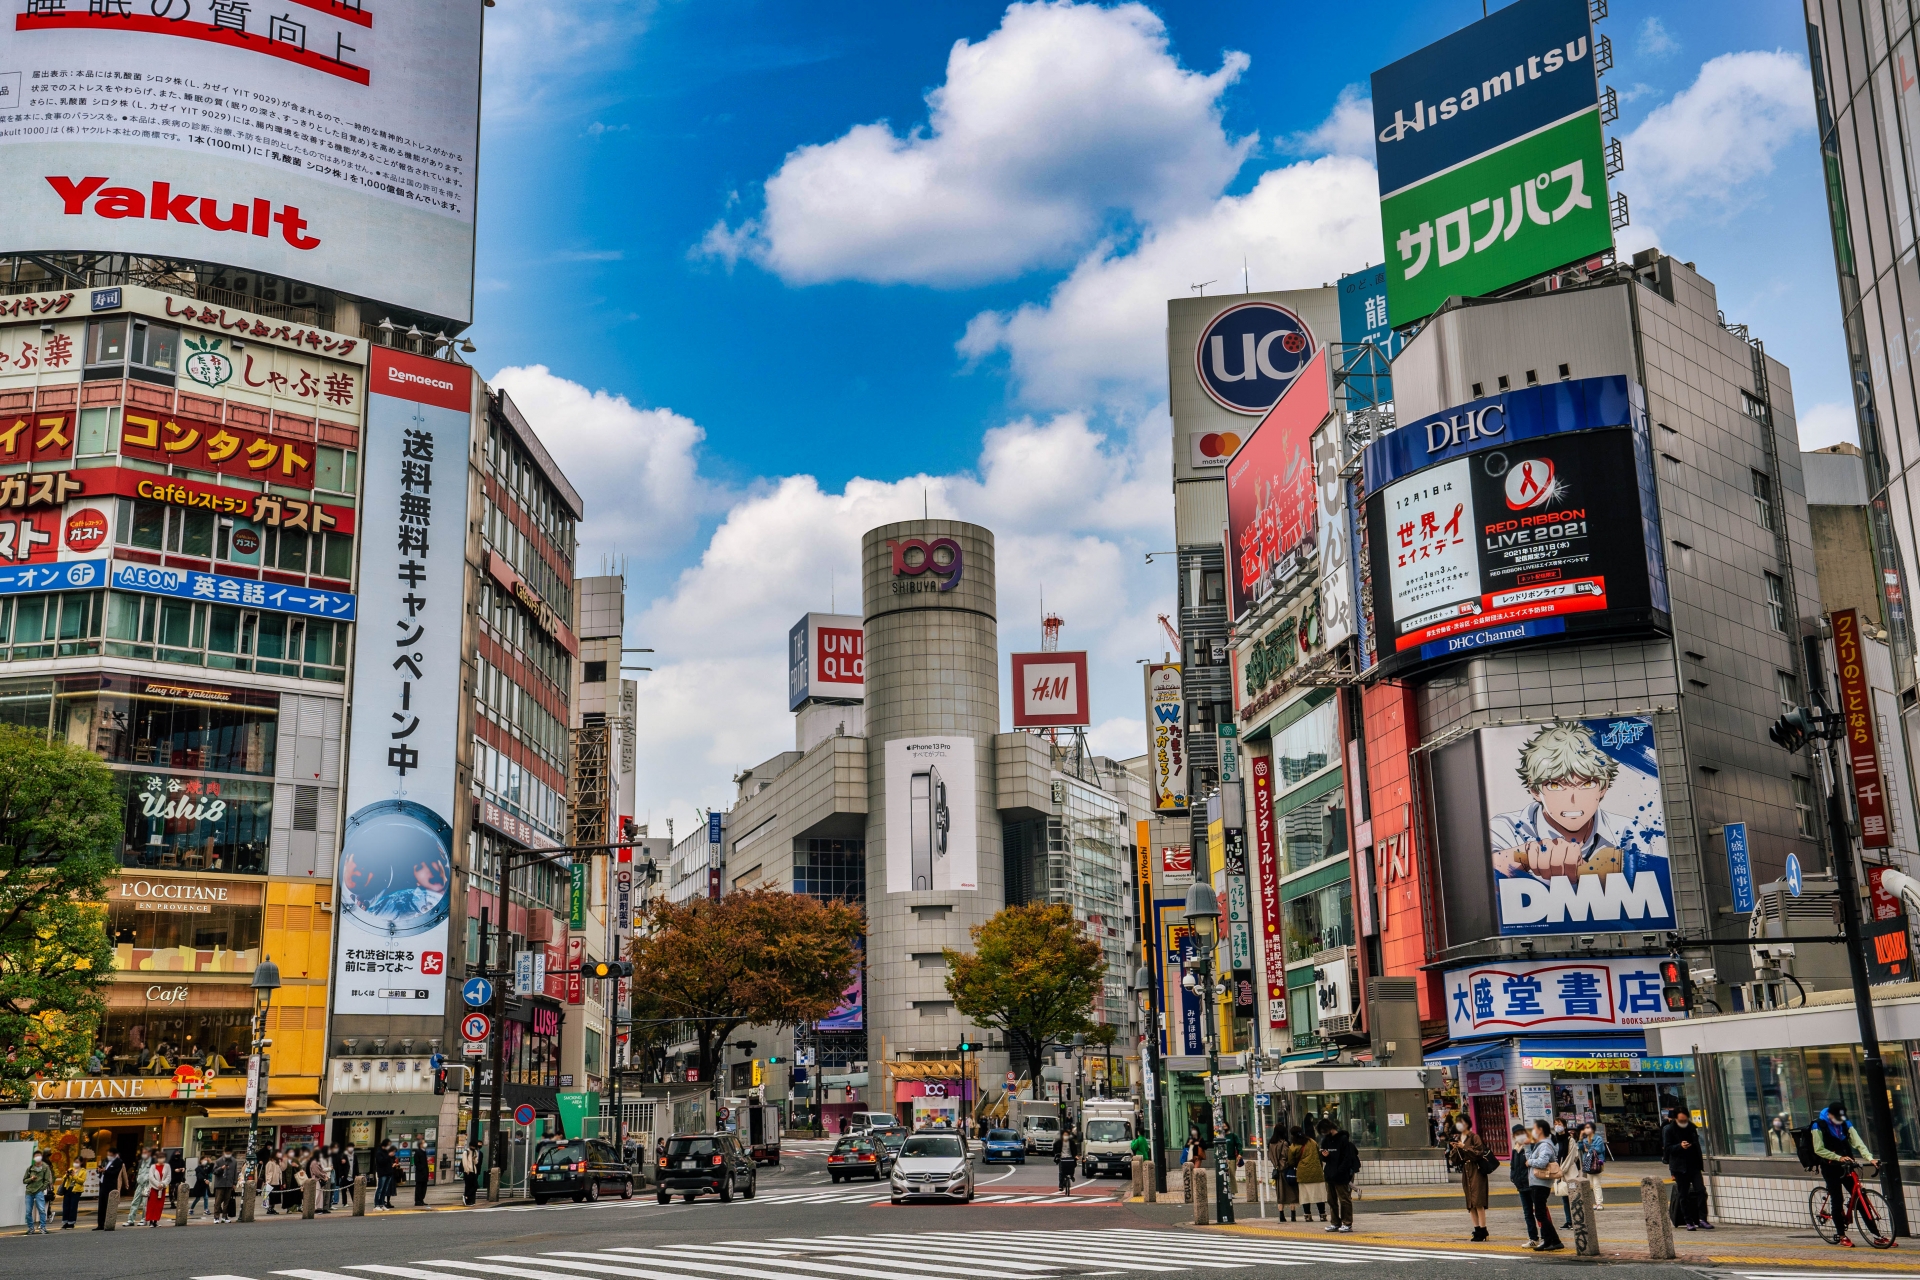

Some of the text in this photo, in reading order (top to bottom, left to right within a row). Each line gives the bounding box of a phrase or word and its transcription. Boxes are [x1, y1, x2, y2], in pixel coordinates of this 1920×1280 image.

[232, 87, 250, 98] YIT
[1378, 36, 1587, 143] Hisamitsu
[181, 107, 198, 116] YIT
[45, 176, 321, 250] Yakult
[1396, 159, 1592, 281] サロンパス
[94, 290, 118, 306] 寿司
[1364, 294, 1388, 330] 龍
[165, 297, 357, 357] しゃぶしゃぶバイキング
[1210, 329, 1305, 382] UC
[243, 354, 354, 406] しゃぶ葉
[388, 367, 453, 391] Demaecan
[1424, 403, 1505, 453] DHC
[124, 414, 308, 475] コンタクト
[138, 479, 336, 534] Caféレストラン ガスト
[1485, 508, 1586, 536] RED RIBBON
[69, 527, 104, 541] ガスト
[1316, 429, 1350, 634] もんじゃ
[1486, 521, 1587, 550] LIVE 2021
[887, 538, 962, 591] 109
[1397, 537, 1464, 568] エイズデー
[70, 566, 92, 582] 6F
[121, 566, 179, 589] AEON
[892, 581, 936, 593] SHIBUYA
[387, 427, 434, 777] 送料無料キャンペーン中
[1502, 586, 1566, 603] レッドリボンライブ
[823, 634, 862, 655] UNI
[1448, 625, 1526, 651] DHC Channel
[823, 656, 864, 679] QLO
[1837, 615, 1869, 744] クスリのことなら
[1032, 676, 1069, 701] H&M
[1609, 721, 1648, 735] ブルー
[621, 714, 635, 774] CMERA
[1223, 739, 1236, 772] 渋谷西村
[139, 791, 226, 822] Ushi8
[1854, 754, 1887, 837] 三千里
[1257, 790, 1276, 922] ウィンターフルーツギフト
[1729, 828, 1751, 909] 大盛堂商事ビル
[157, 903, 209, 913] PROVENCE
[1498, 871, 1669, 925] DMM
[346, 949, 414, 961] それ渋谷に来る
[1272, 934, 1284, 987] 無料配送地域
[522, 954, 530, 992] 渋谷駅前
[570, 964, 579, 990] アコム
[146, 984, 189, 1006] Café
[351, 989, 374, 997] 詳しくは
[1453, 971, 1662, 1024] 大盛堂書店
[534, 1007, 558, 1037] LUSH
[1187, 1010, 1197, 1048] みずほ銀行
[343, 1061, 421, 1072] 渋谷駅前ビ
